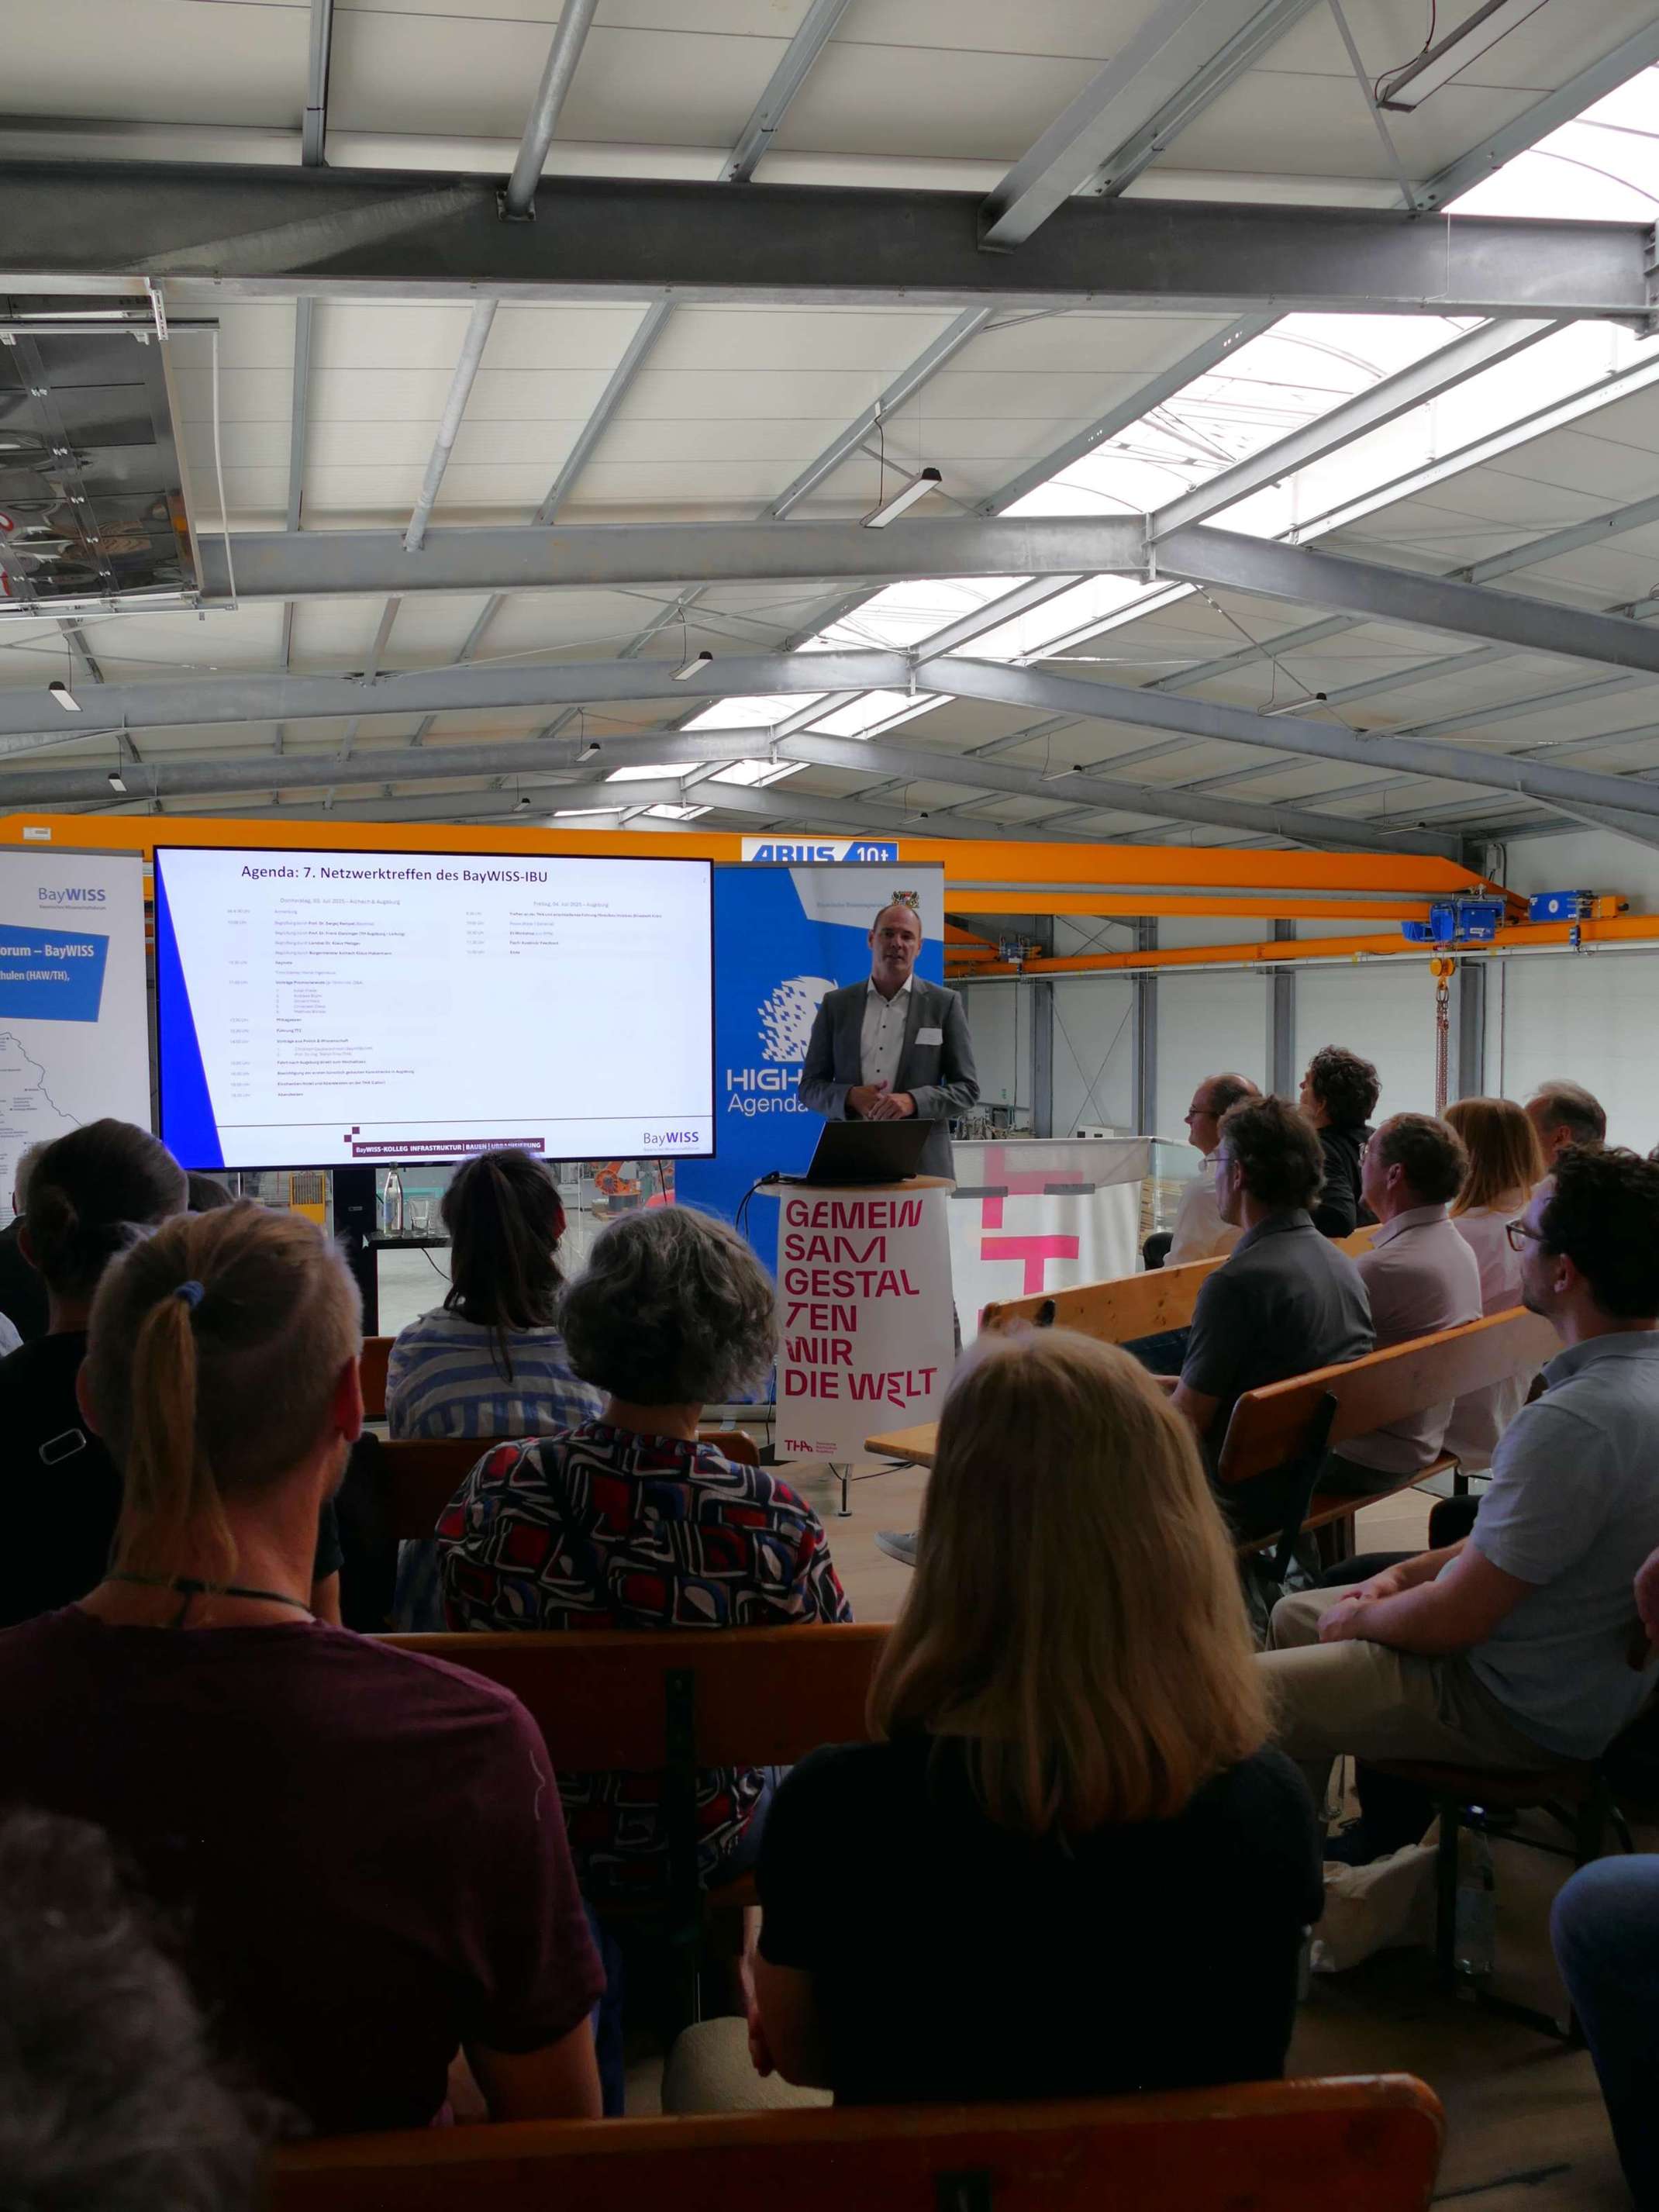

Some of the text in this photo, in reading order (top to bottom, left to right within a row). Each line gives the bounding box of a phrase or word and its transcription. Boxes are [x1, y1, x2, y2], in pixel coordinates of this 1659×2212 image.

[751, 844, 889, 861] ABUS 10t
[242, 865, 547, 884] Agenda: 7. Netzwerktreffen des BayWISS-IBU
[39, 887, 106, 904] BayWISS
[0, 947, 31, 957] orum
[44, 944, 94, 959] BayWISS
[26, 970, 71, 982] (HAW/TH),
[727, 1092, 809, 1116] Agenda
[356, 1144, 409, 1154] BayWISS-KOLLEG
[409, 1144, 462, 1152] INFRASTRUKTUR
[643, 1131, 699, 1147] BayWISS
[785, 1199, 923, 1229] GEMEIN
[785, 1234, 886, 1263] SAM
[785, 1268, 920, 1298] GESTAL
[785, 1302, 857, 1332] TEN
[785, 1336, 854, 1366] WIR
[785, 1368, 938, 1409] DIE WELT
